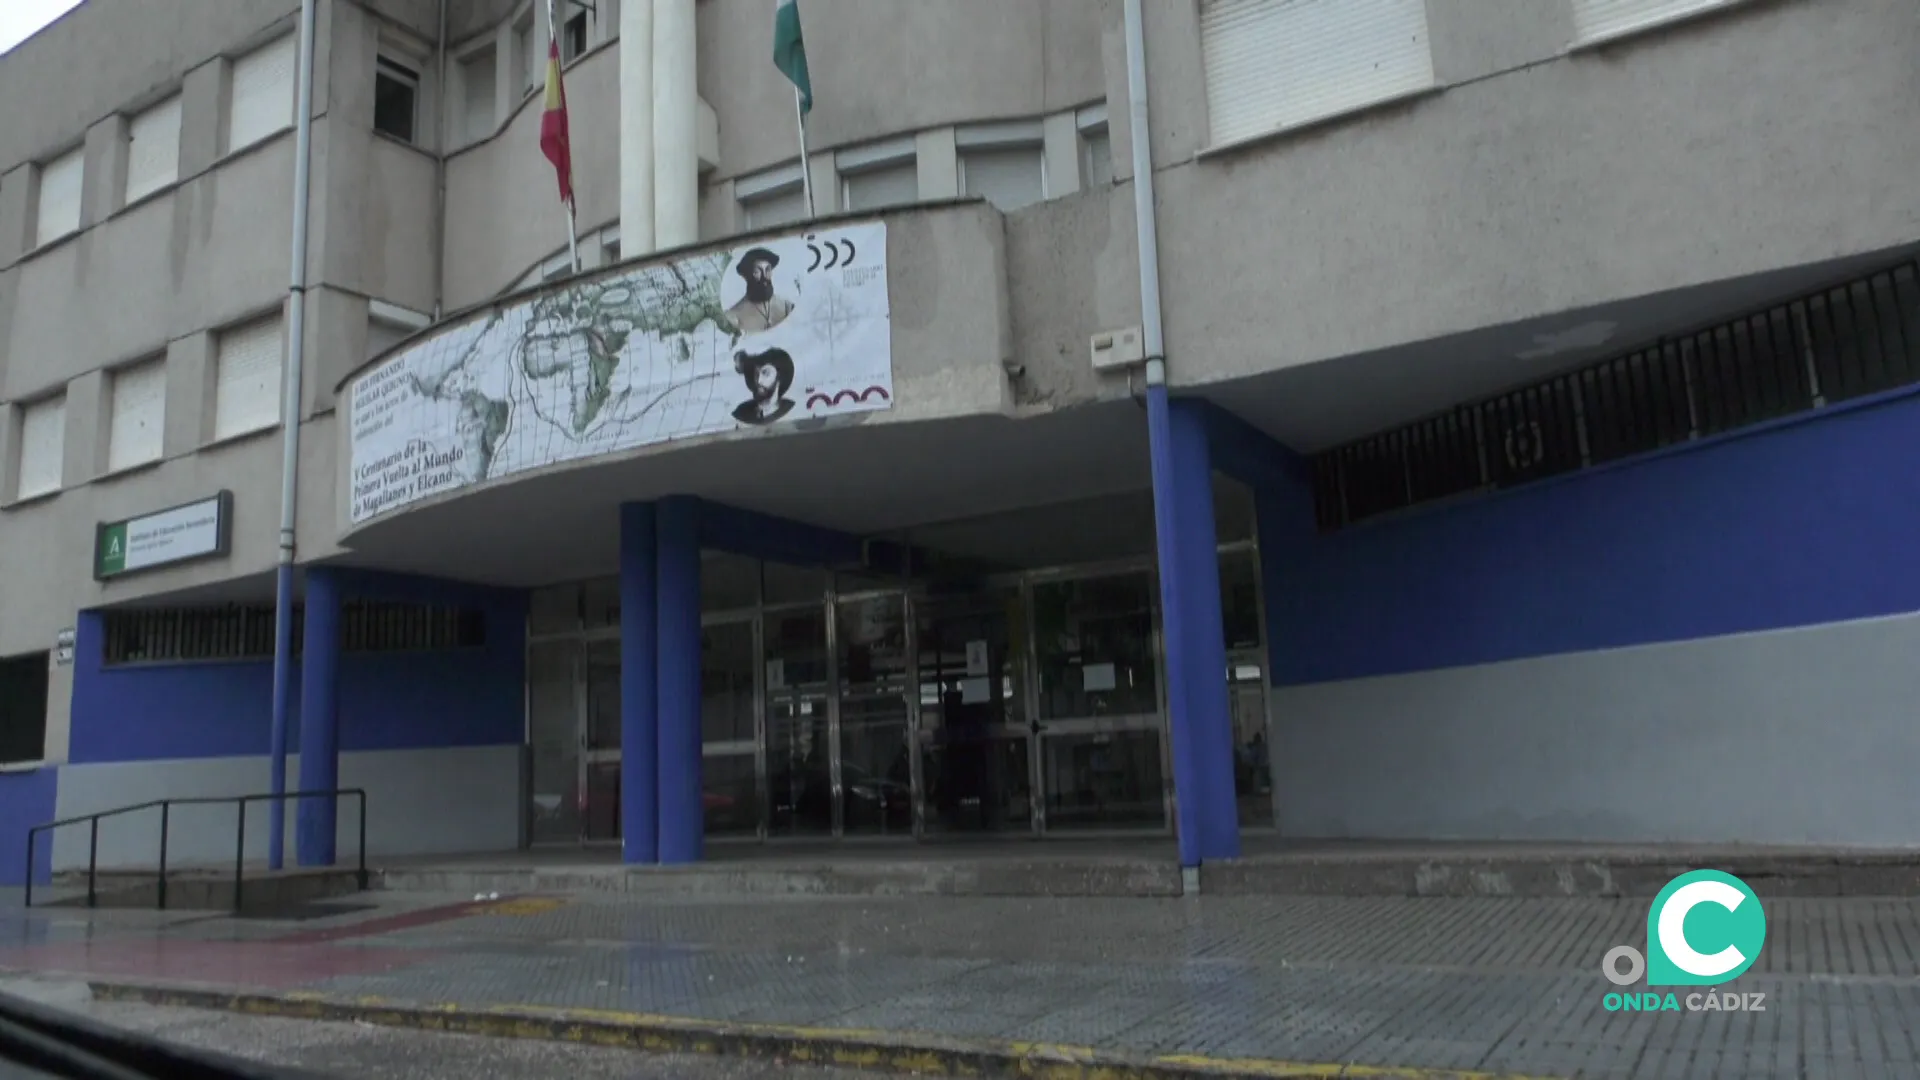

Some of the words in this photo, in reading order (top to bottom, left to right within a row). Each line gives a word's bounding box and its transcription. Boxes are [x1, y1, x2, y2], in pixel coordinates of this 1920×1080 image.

[369, 359, 405, 388] FERNANDO
[355, 478, 381, 501] Primera
[383, 463, 409, 486] Vuelta
[412, 457, 421, 475] al
[424, 444, 463, 469] Mundo
[361, 450, 402, 479] Centenario
[404, 443, 415, 459] de
[418, 439, 427, 454] la
[363, 486, 406, 516] Magallanes
[409, 482, 415, 499] y
[418, 471, 452, 491] Elcano
